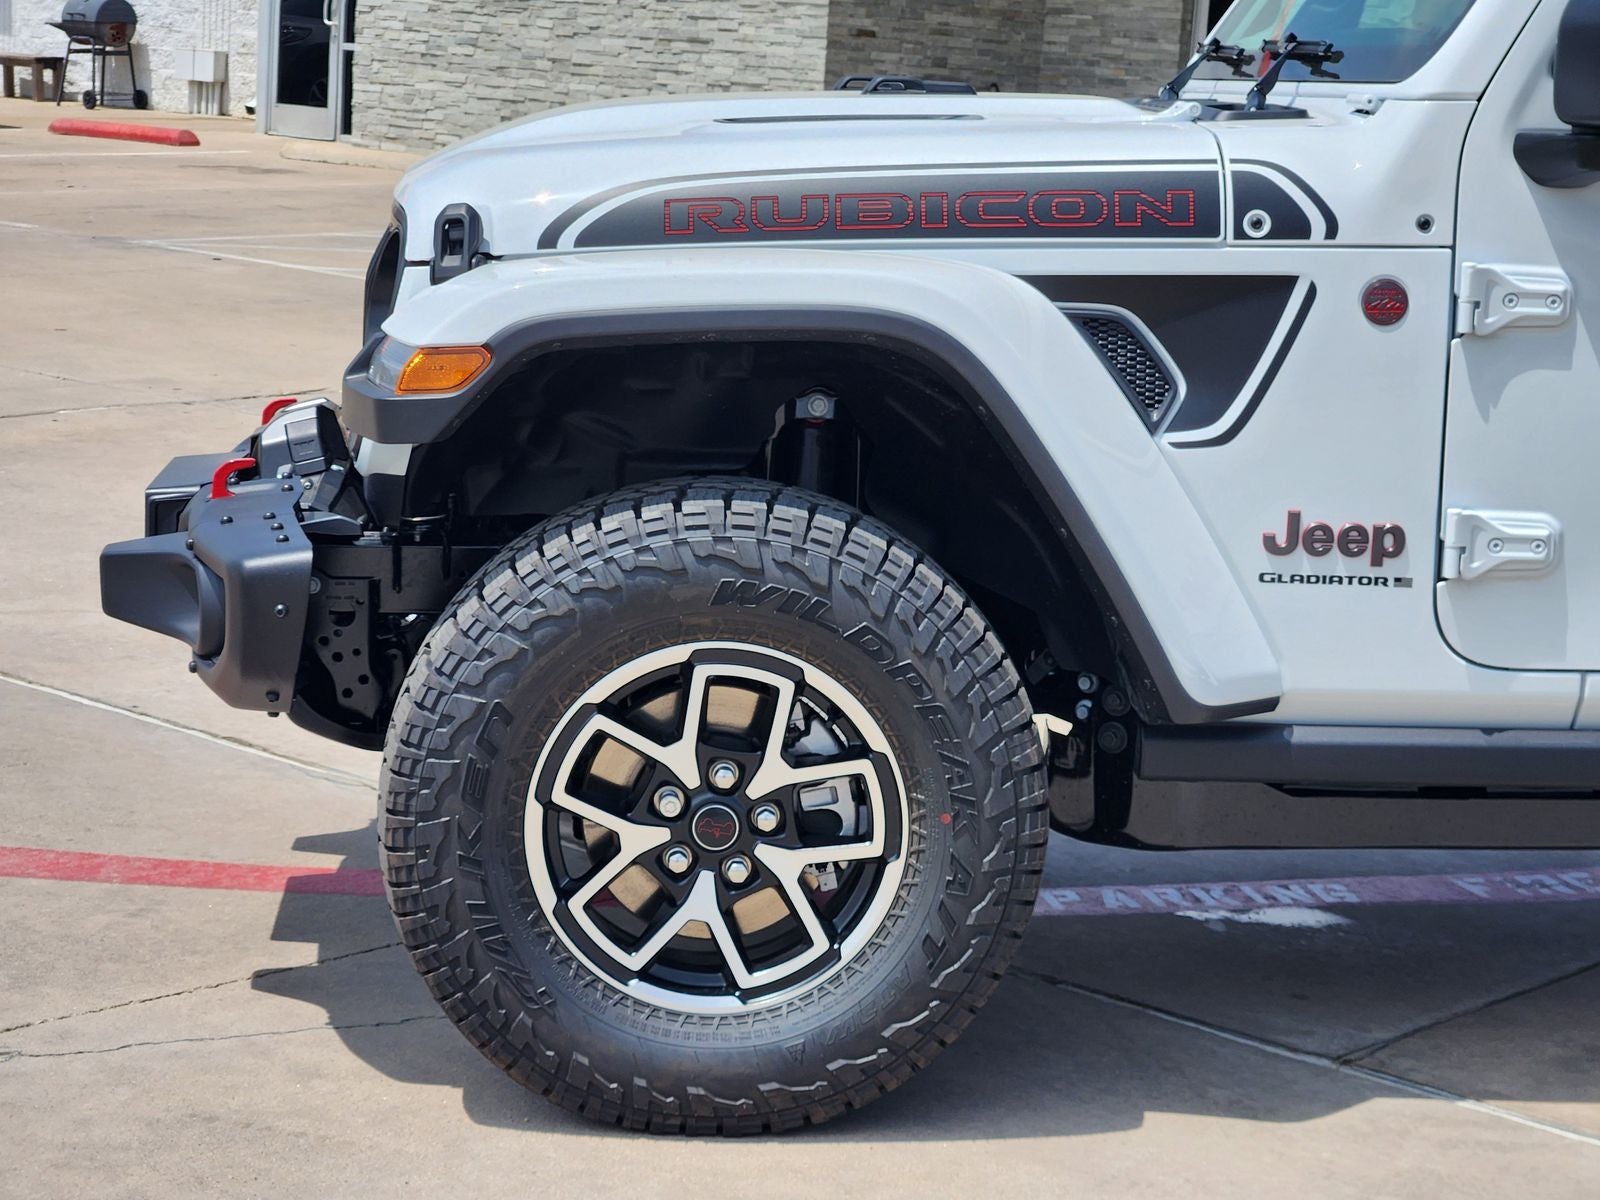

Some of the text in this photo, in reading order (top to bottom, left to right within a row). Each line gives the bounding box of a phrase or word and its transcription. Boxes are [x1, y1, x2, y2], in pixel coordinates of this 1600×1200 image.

[664, 189, 1195, 235] RUBICON
[1262, 509, 1406, 567] Jeep
[1258, 572, 1389, 588] GLADIATOR
[708, 578, 981, 845] WILDPEAK
[1038, 882, 1362, 911] PARKING
